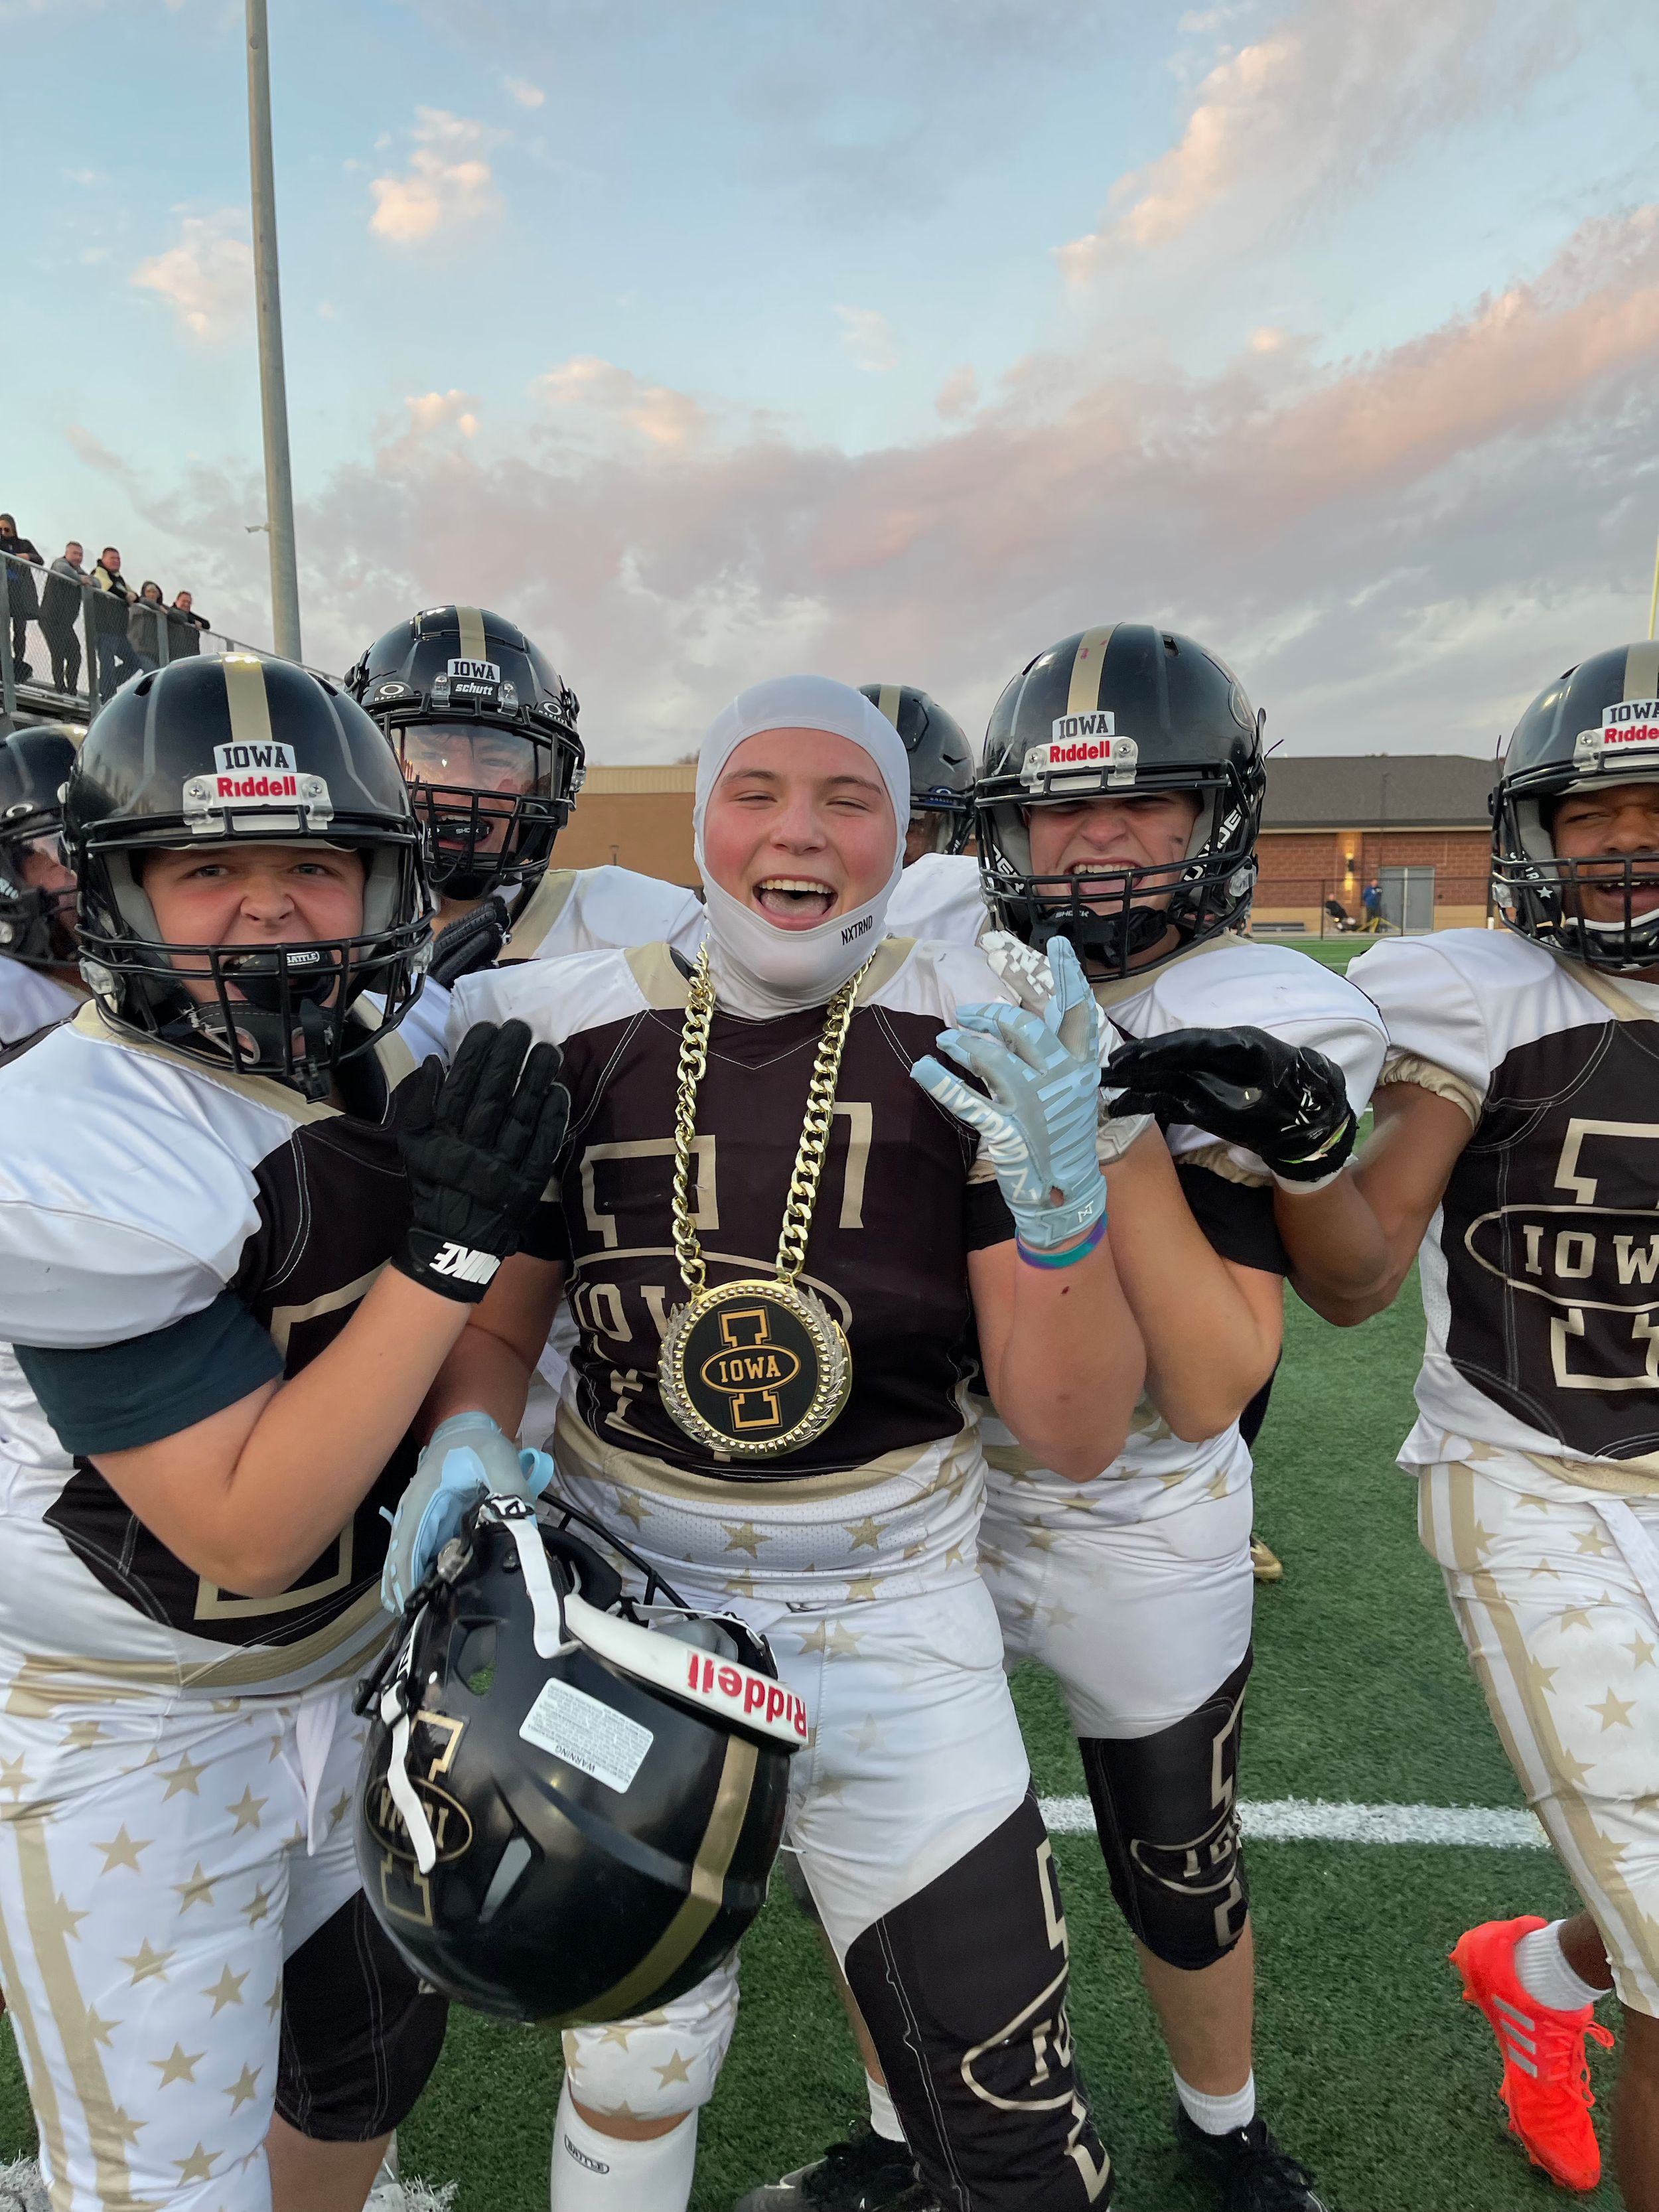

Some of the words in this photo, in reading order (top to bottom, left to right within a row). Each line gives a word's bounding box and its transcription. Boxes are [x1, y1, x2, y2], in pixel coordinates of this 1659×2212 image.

[453, 661, 495, 680] IOWA
[455, 682, 493, 696] schutt
[1610, 702, 1659, 724] IOWA
[1059, 714, 1108, 739] IOWA
[222, 745, 289, 770] IOWA
[1050, 740, 1110, 763] Riddell
[217, 776, 297, 797] Riddell
[841, 915, 873, 946] NXTRND
[429, 1242, 501, 1285] NIKE
[719, 1355, 781, 1382] IOWA
[688, 1653, 807, 1737] Riddell
[555, 1745, 595, 1773] WARNING
